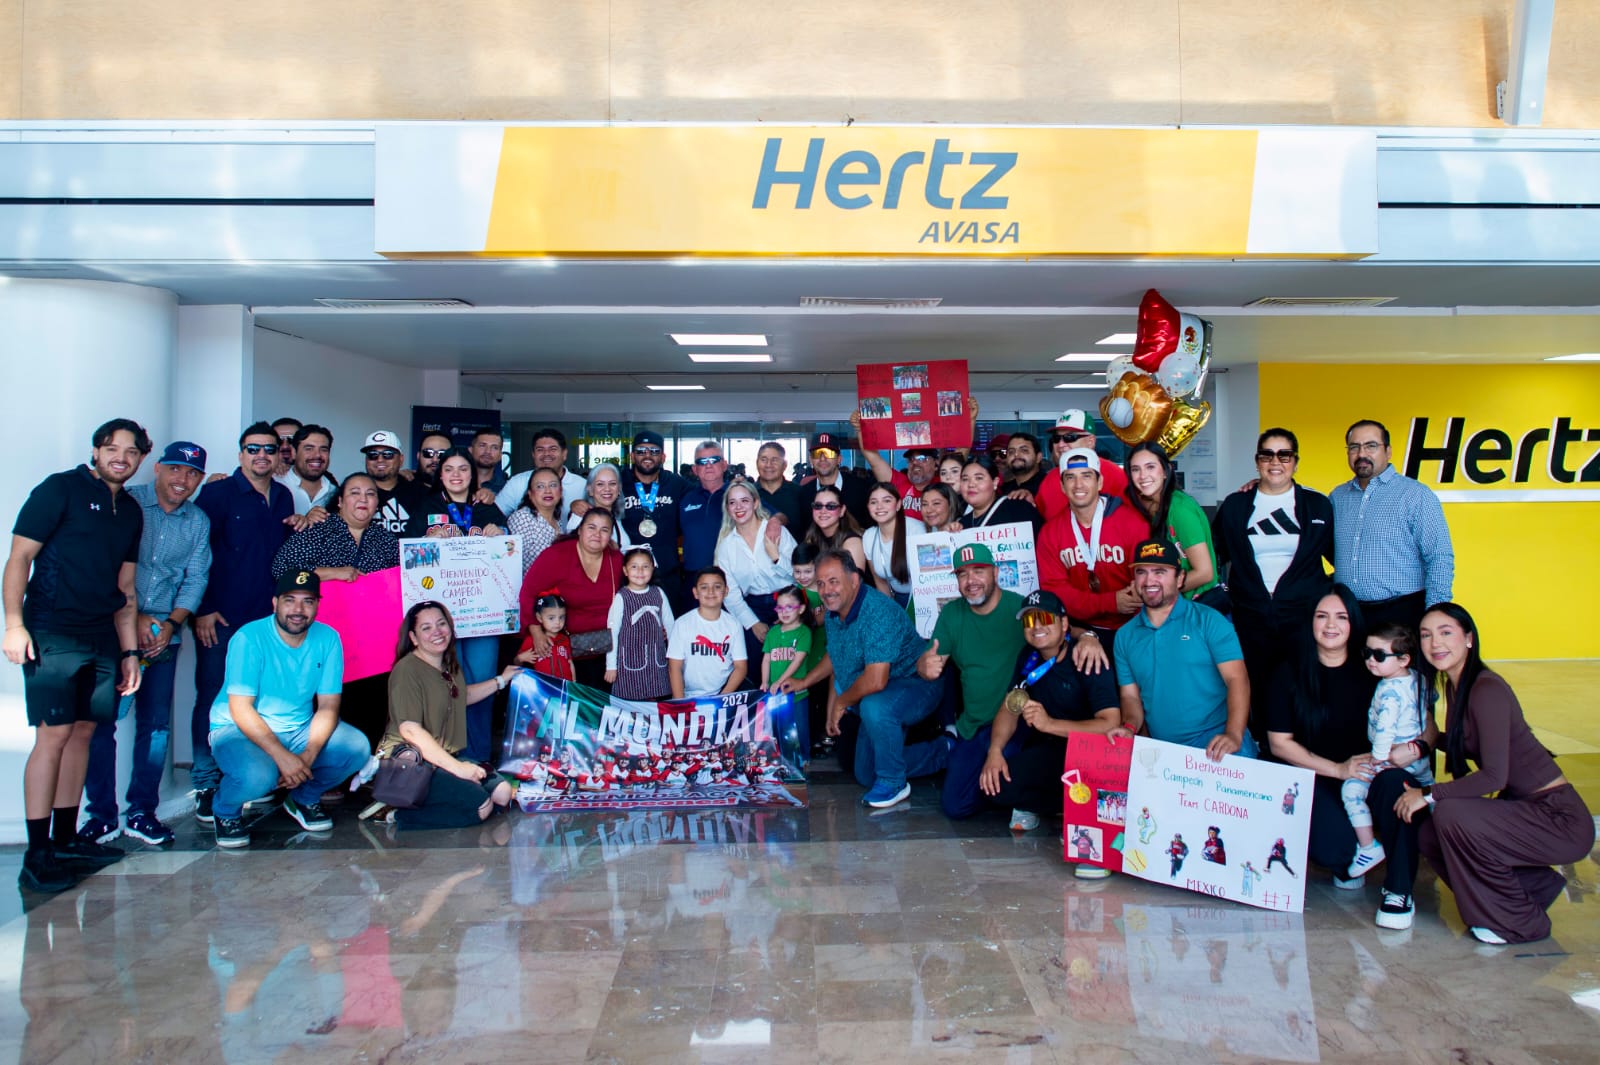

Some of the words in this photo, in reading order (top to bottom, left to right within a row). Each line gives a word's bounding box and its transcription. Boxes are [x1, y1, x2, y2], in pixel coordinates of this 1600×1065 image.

[752, 138, 1018, 210] Hertz
[918, 221, 1019, 243] AVASA
[440, 567, 490, 579] BIENVENIDO
[722, 692, 749, 709] 2027
[536, 696, 584, 741] AL
[597, 700, 775, 746] MUNDIAL
[1185, 753, 1245, 780] Bienvenido
[1215, 780, 1273, 802] Panamericano
[1204, 798, 1249, 820] CARDONA
[1186, 878, 1226, 897] MEXICO
